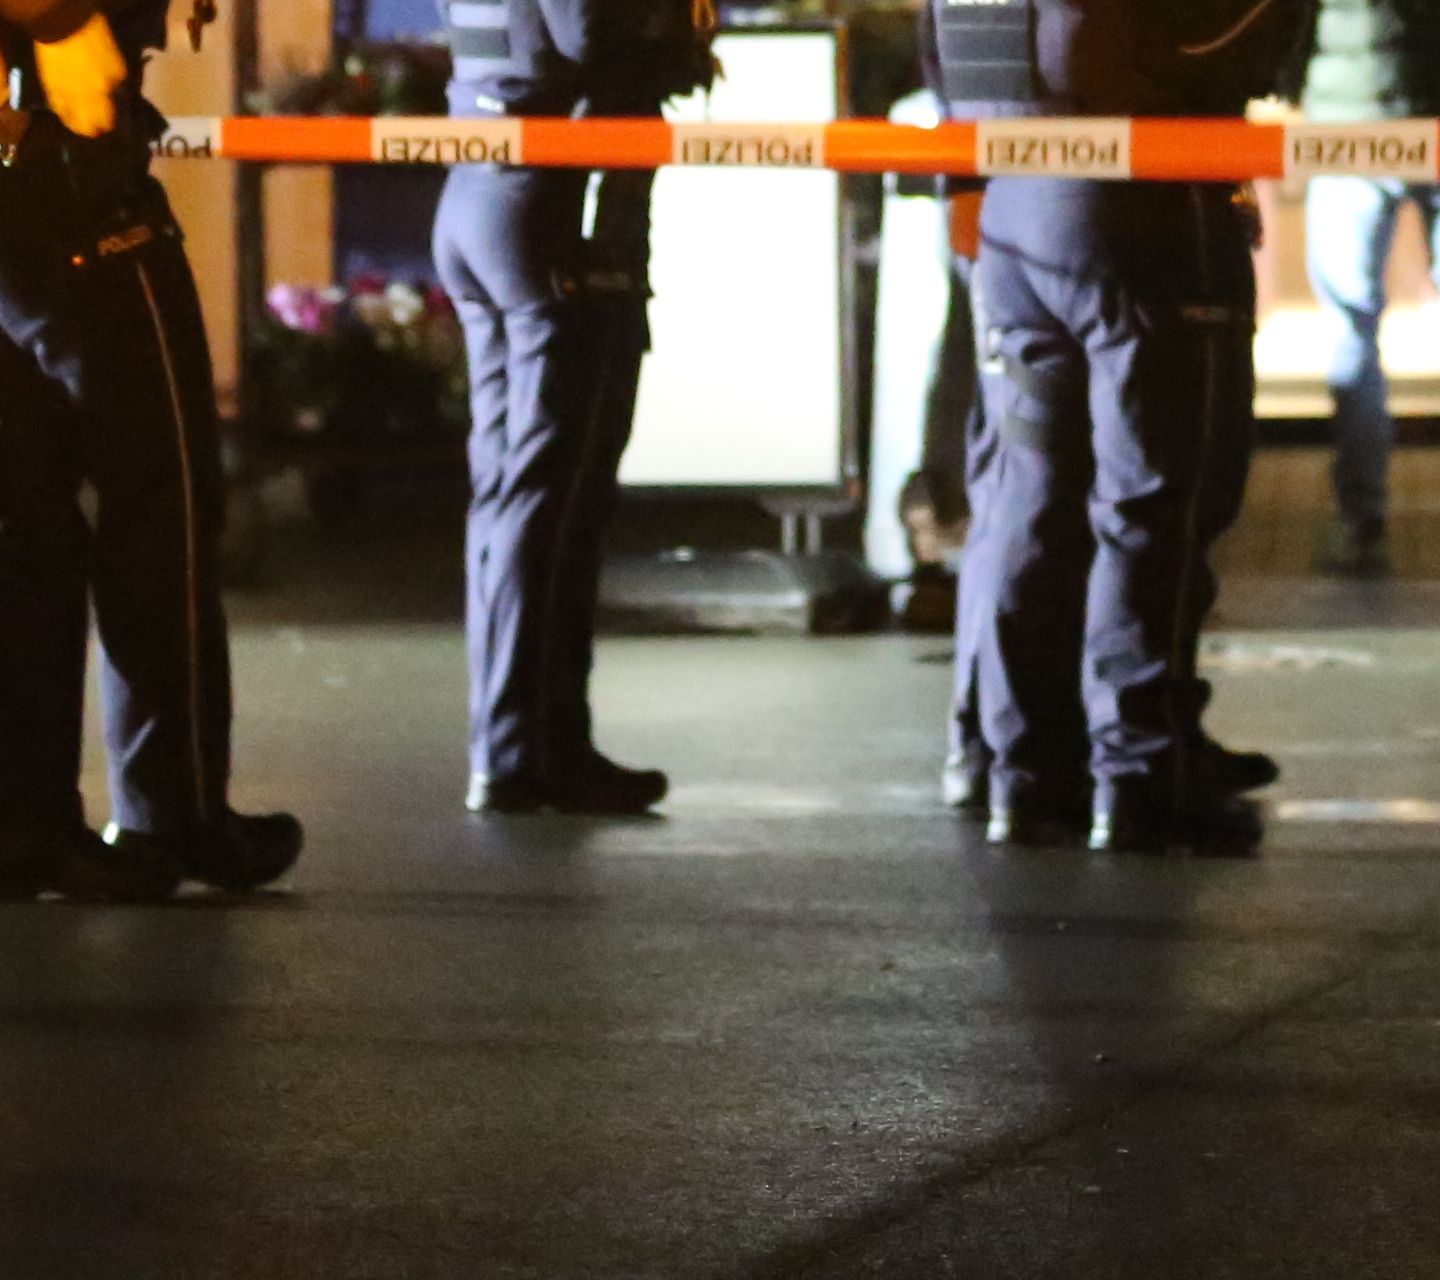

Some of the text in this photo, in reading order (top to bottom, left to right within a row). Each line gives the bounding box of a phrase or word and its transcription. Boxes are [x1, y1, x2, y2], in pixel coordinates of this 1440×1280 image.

[381, 136, 511, 163] POLIZEI
[681, 136, 812, 166] POLIZEI
[985, 134, 1119, 166] POLIZEI
[1293, 133, 1427, 166] POLIZEI
